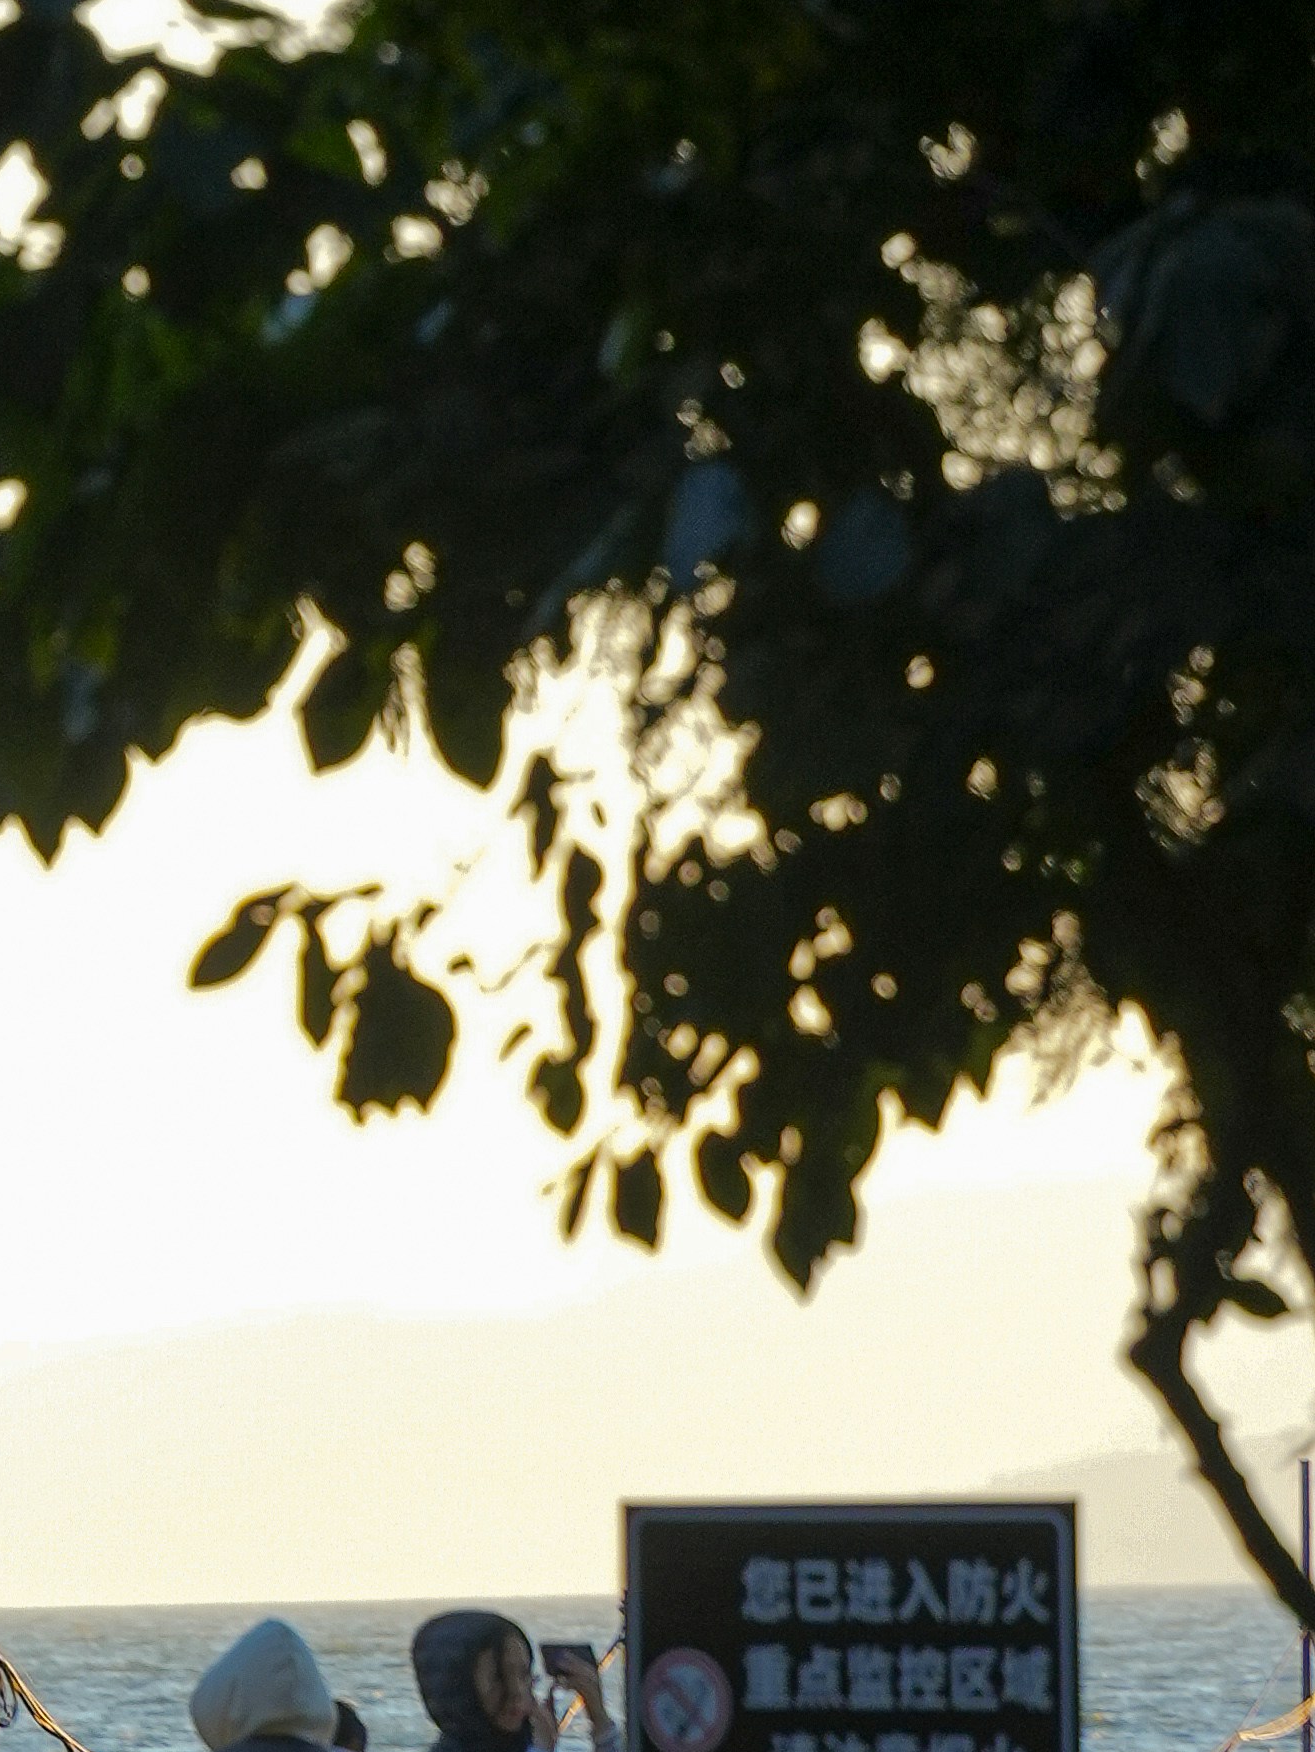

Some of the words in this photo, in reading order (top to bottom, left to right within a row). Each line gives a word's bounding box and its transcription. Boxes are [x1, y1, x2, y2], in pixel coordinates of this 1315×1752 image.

[741, 1557, 1052, 1623] 您已进入防火
[741, 1643, 1054, 1712] 重点监控区域
